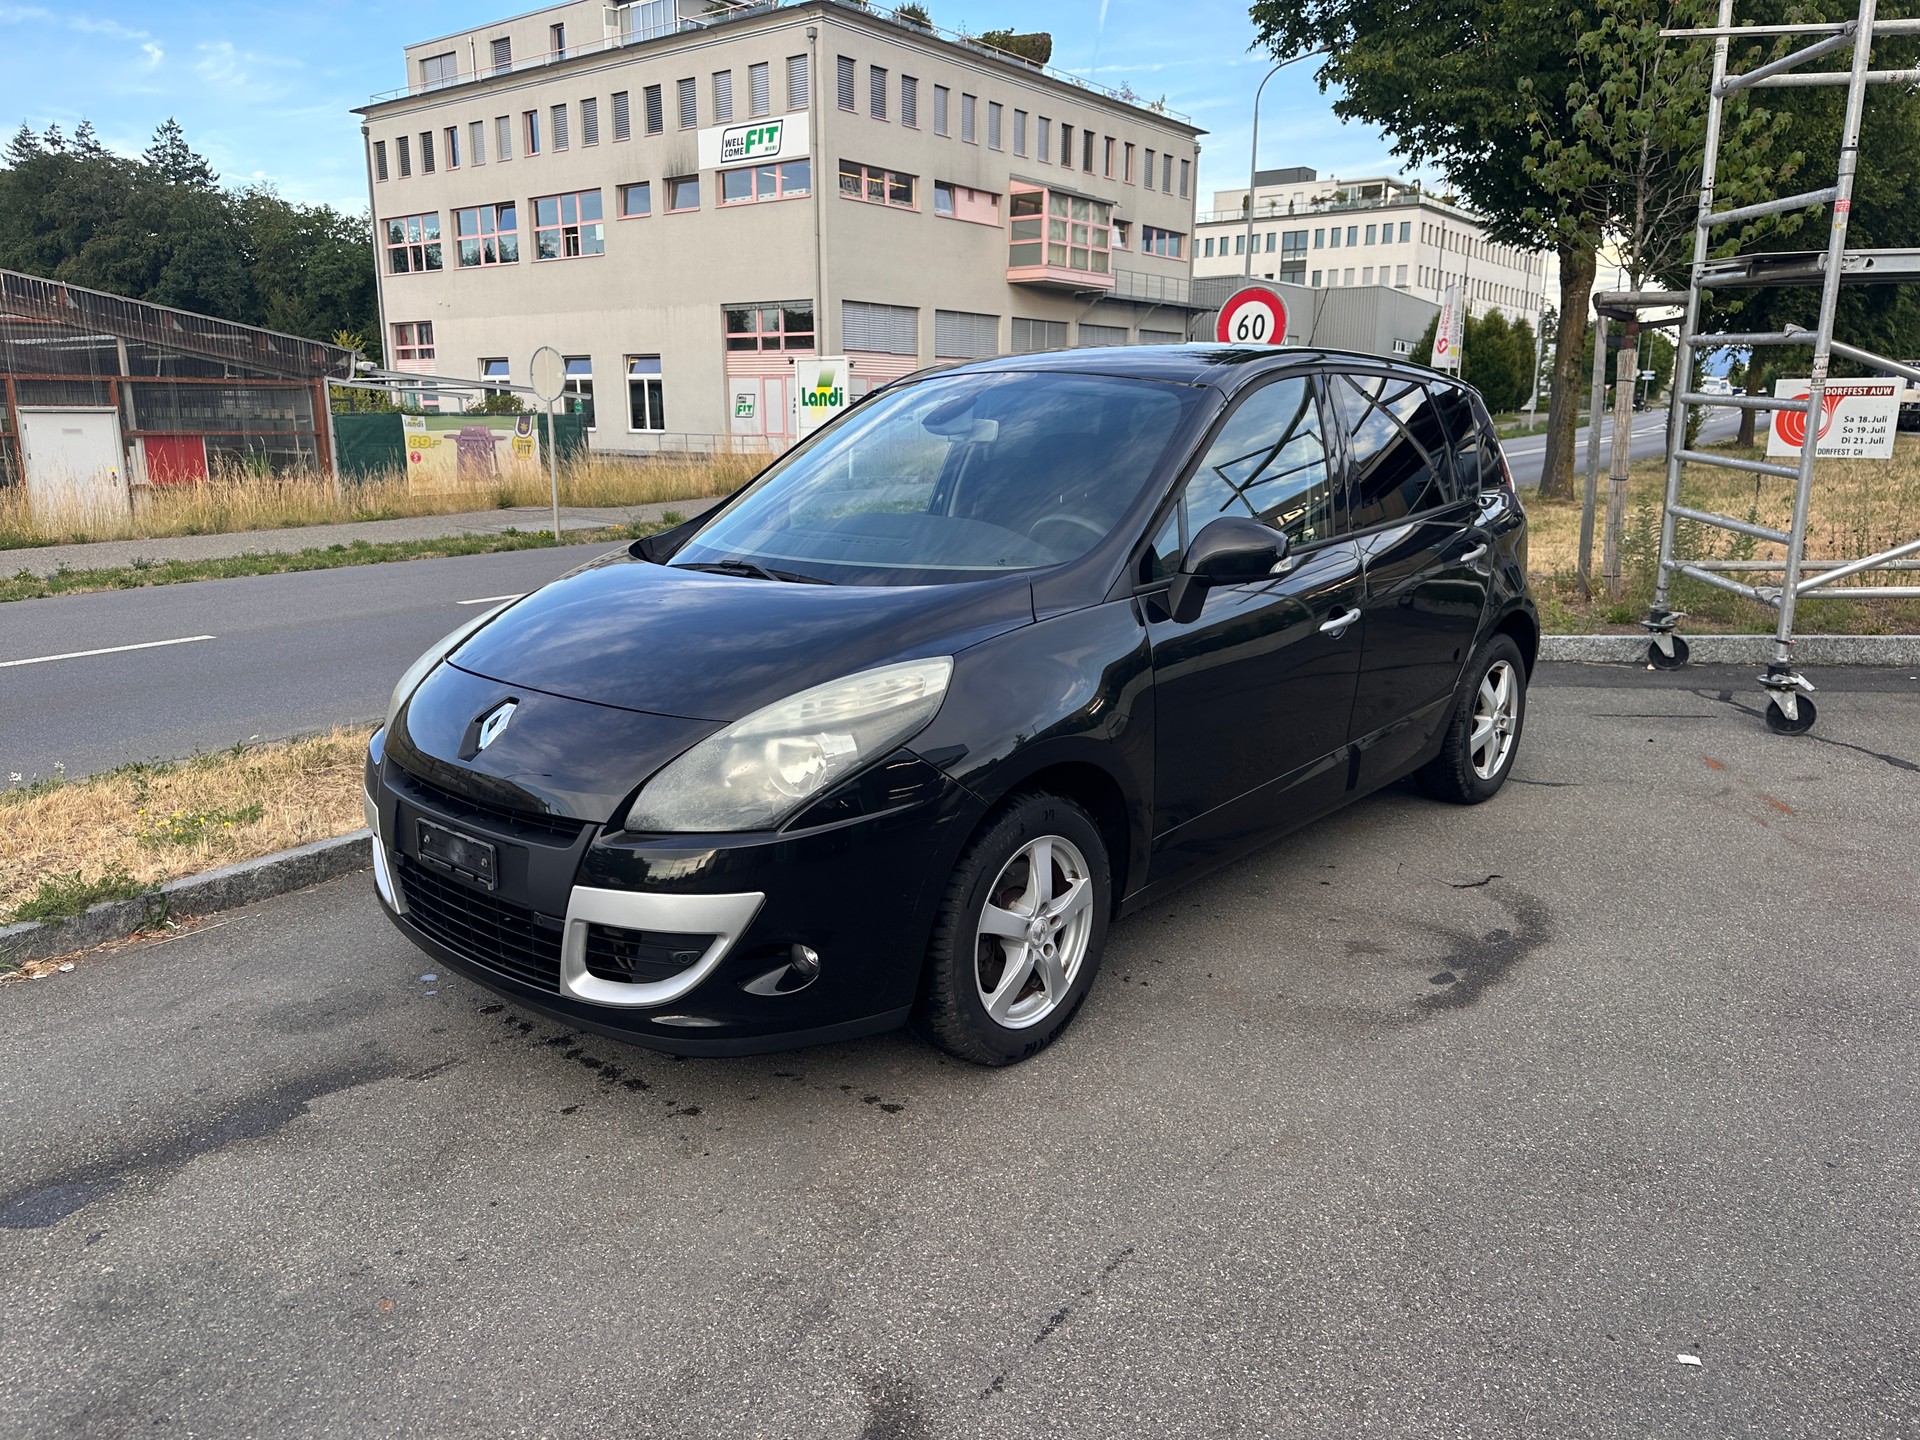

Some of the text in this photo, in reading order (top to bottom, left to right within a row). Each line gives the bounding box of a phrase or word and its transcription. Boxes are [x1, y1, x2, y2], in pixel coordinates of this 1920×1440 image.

[725, 137, 744, 148] WELL
[745, 126, 779, 154] FIT
[725, 147, 744, 157] COME
[1237, 314, 1265, 340] 60
[1825, 387, 1892, 395] DORFFEST AUW
[802, 387, 843, 407] Landi
[738, 405, 752, 415] FIT
[404, 419, 424, 428] Landi
[1842, 426, 1853, 434] So
[1841, 436, 1851, 444] Di
